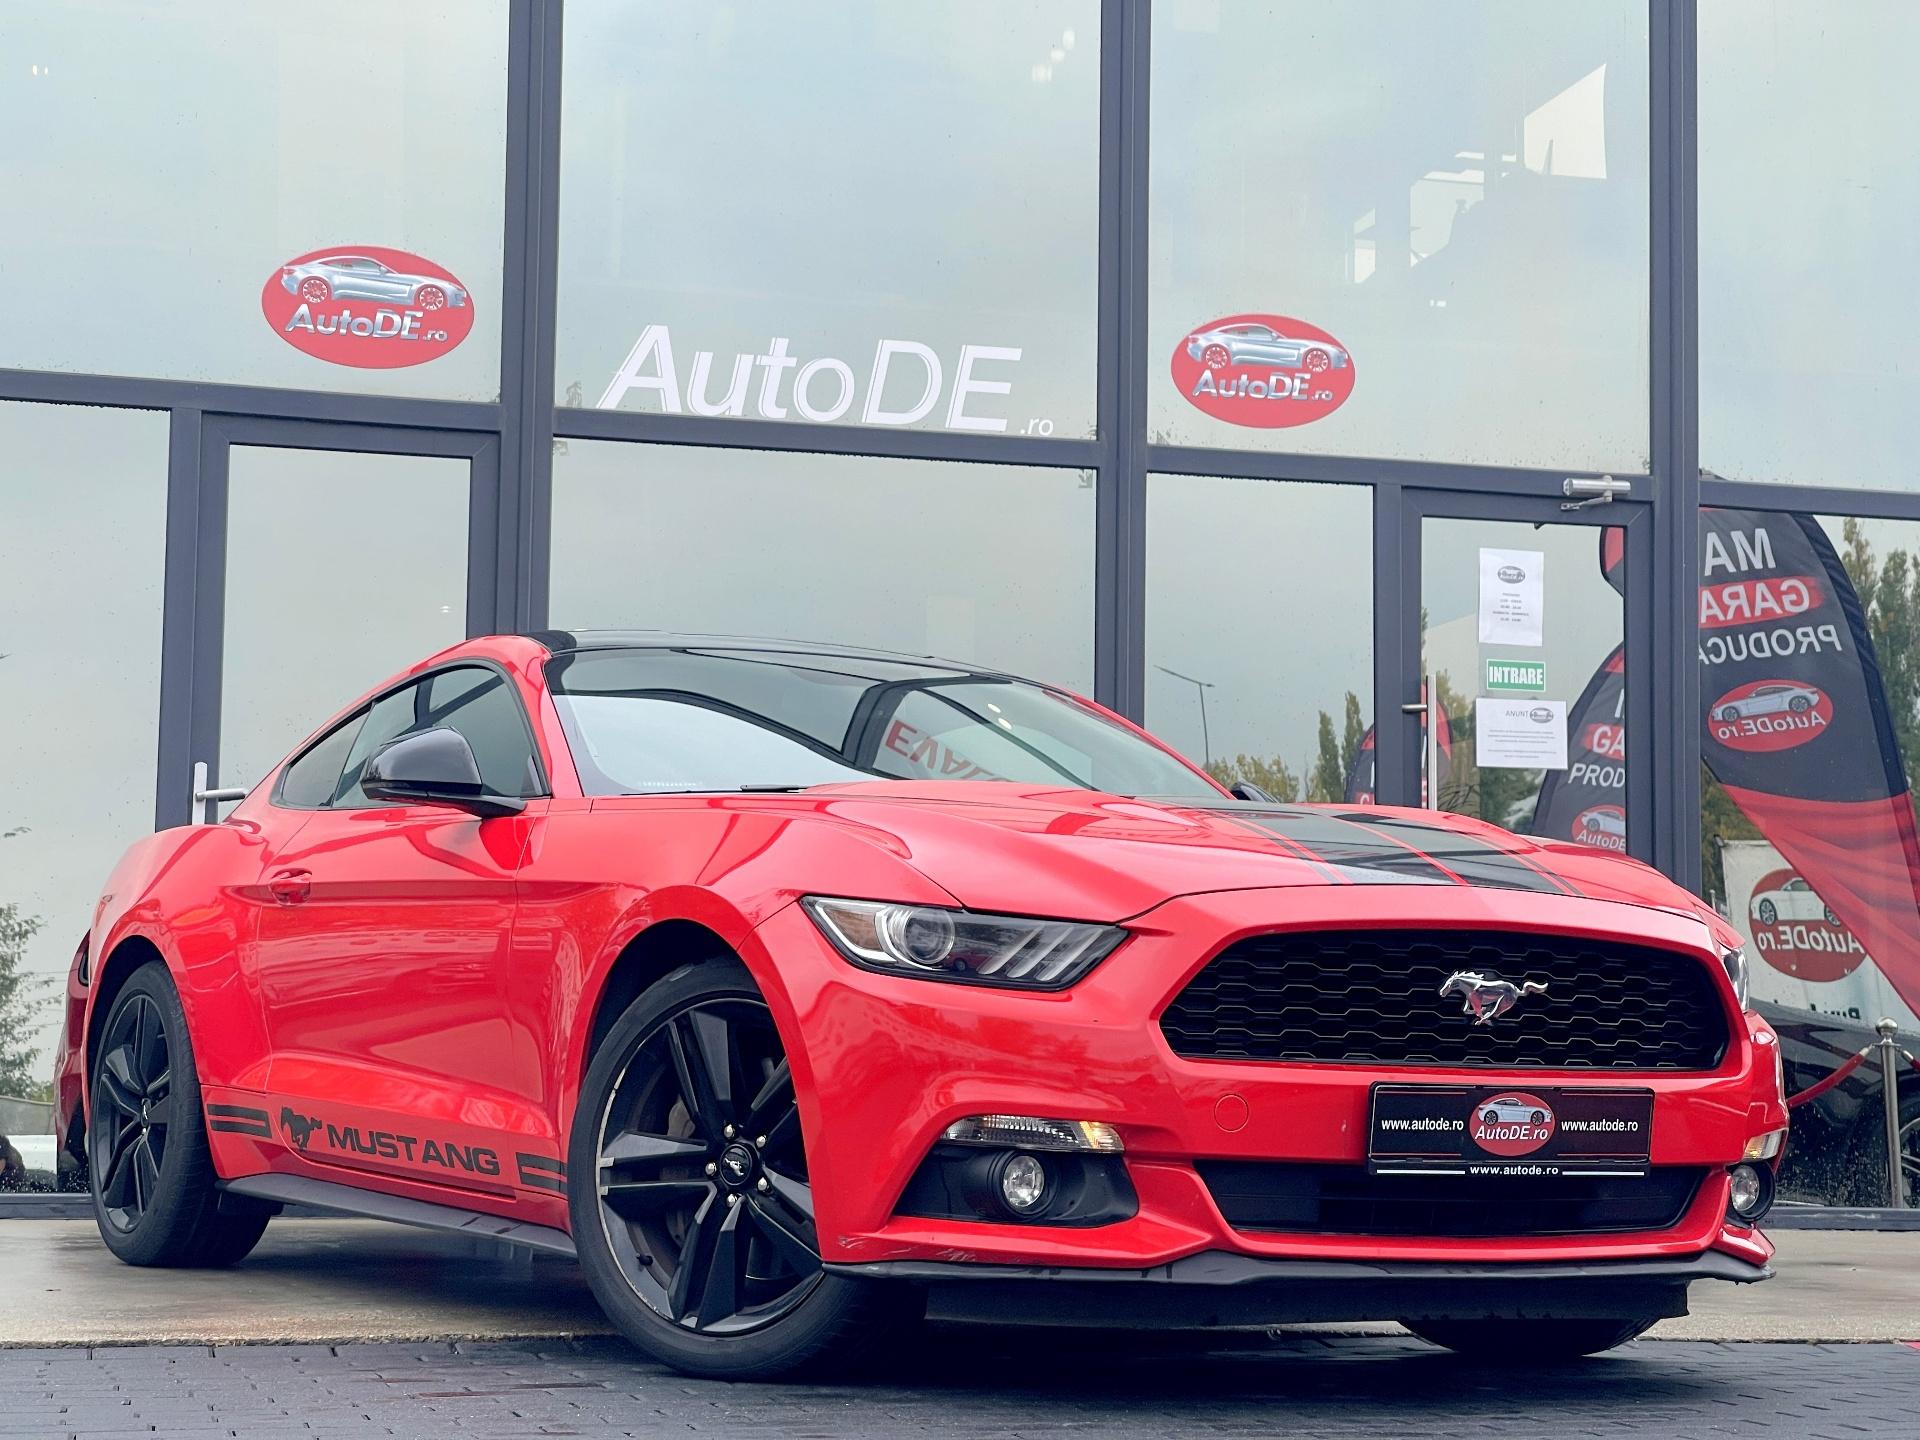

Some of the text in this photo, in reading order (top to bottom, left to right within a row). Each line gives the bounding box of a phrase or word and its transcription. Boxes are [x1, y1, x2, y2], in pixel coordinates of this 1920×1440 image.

[1489, 665, 1544, 686] INTRARE
[1381, 1118, 1464, 1131] www.autode.ro
[1561, 1119, 1638, 1132] www.autode.ro
[1475, 1125, 1548, 1141] AutoDE.ro
[327, 1124, 500, 1175] MUSTANG
[1470, 1166, 1558, 1175] www.autode.ro
